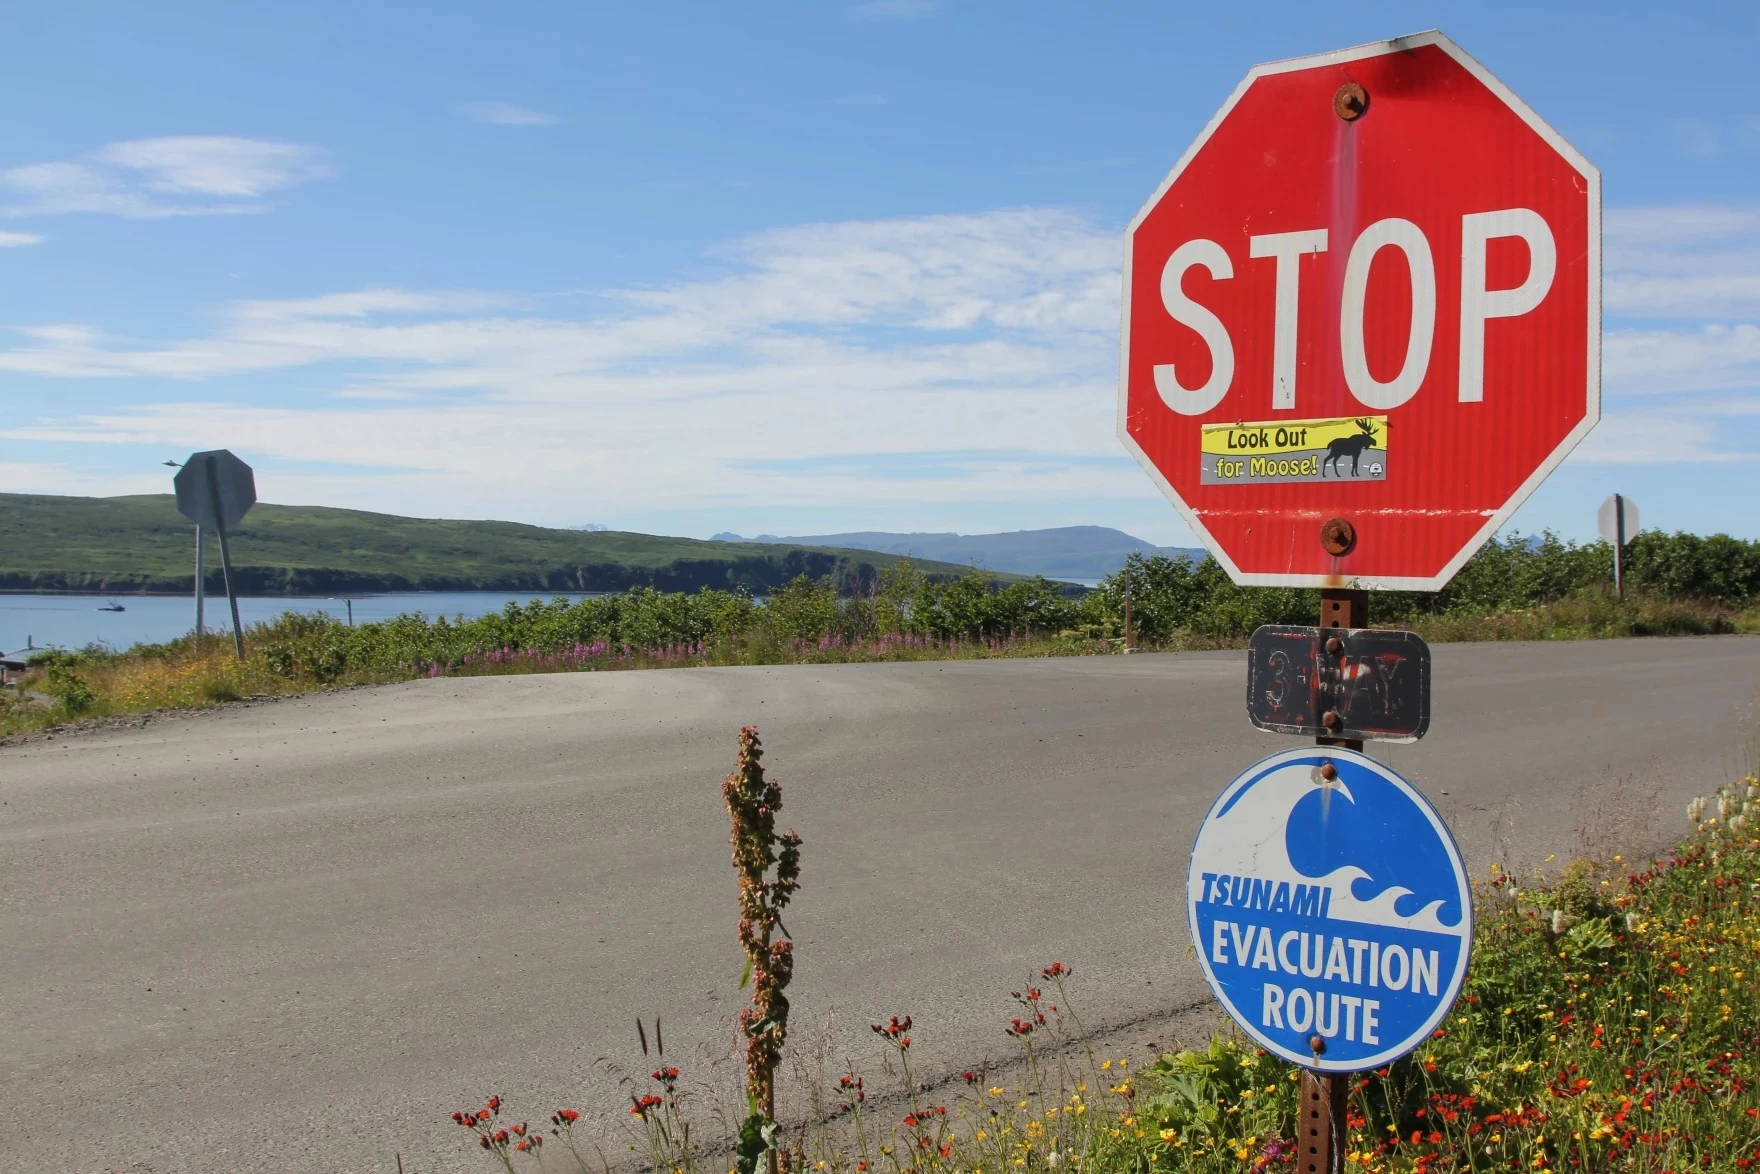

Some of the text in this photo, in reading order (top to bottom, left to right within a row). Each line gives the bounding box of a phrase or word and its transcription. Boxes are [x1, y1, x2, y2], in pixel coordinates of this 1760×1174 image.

[1153, 208, 1557, 416] STOP
[1227, 427, 1308, 449] Look Out
[1216, 455, 1319, 478] for Moose!
[1201, 872, 1332, 919] TSUNAMI
[1212, 920, 1439, 996] EVACUATION
[1262, 983, 1380, 1046] ROUTE
